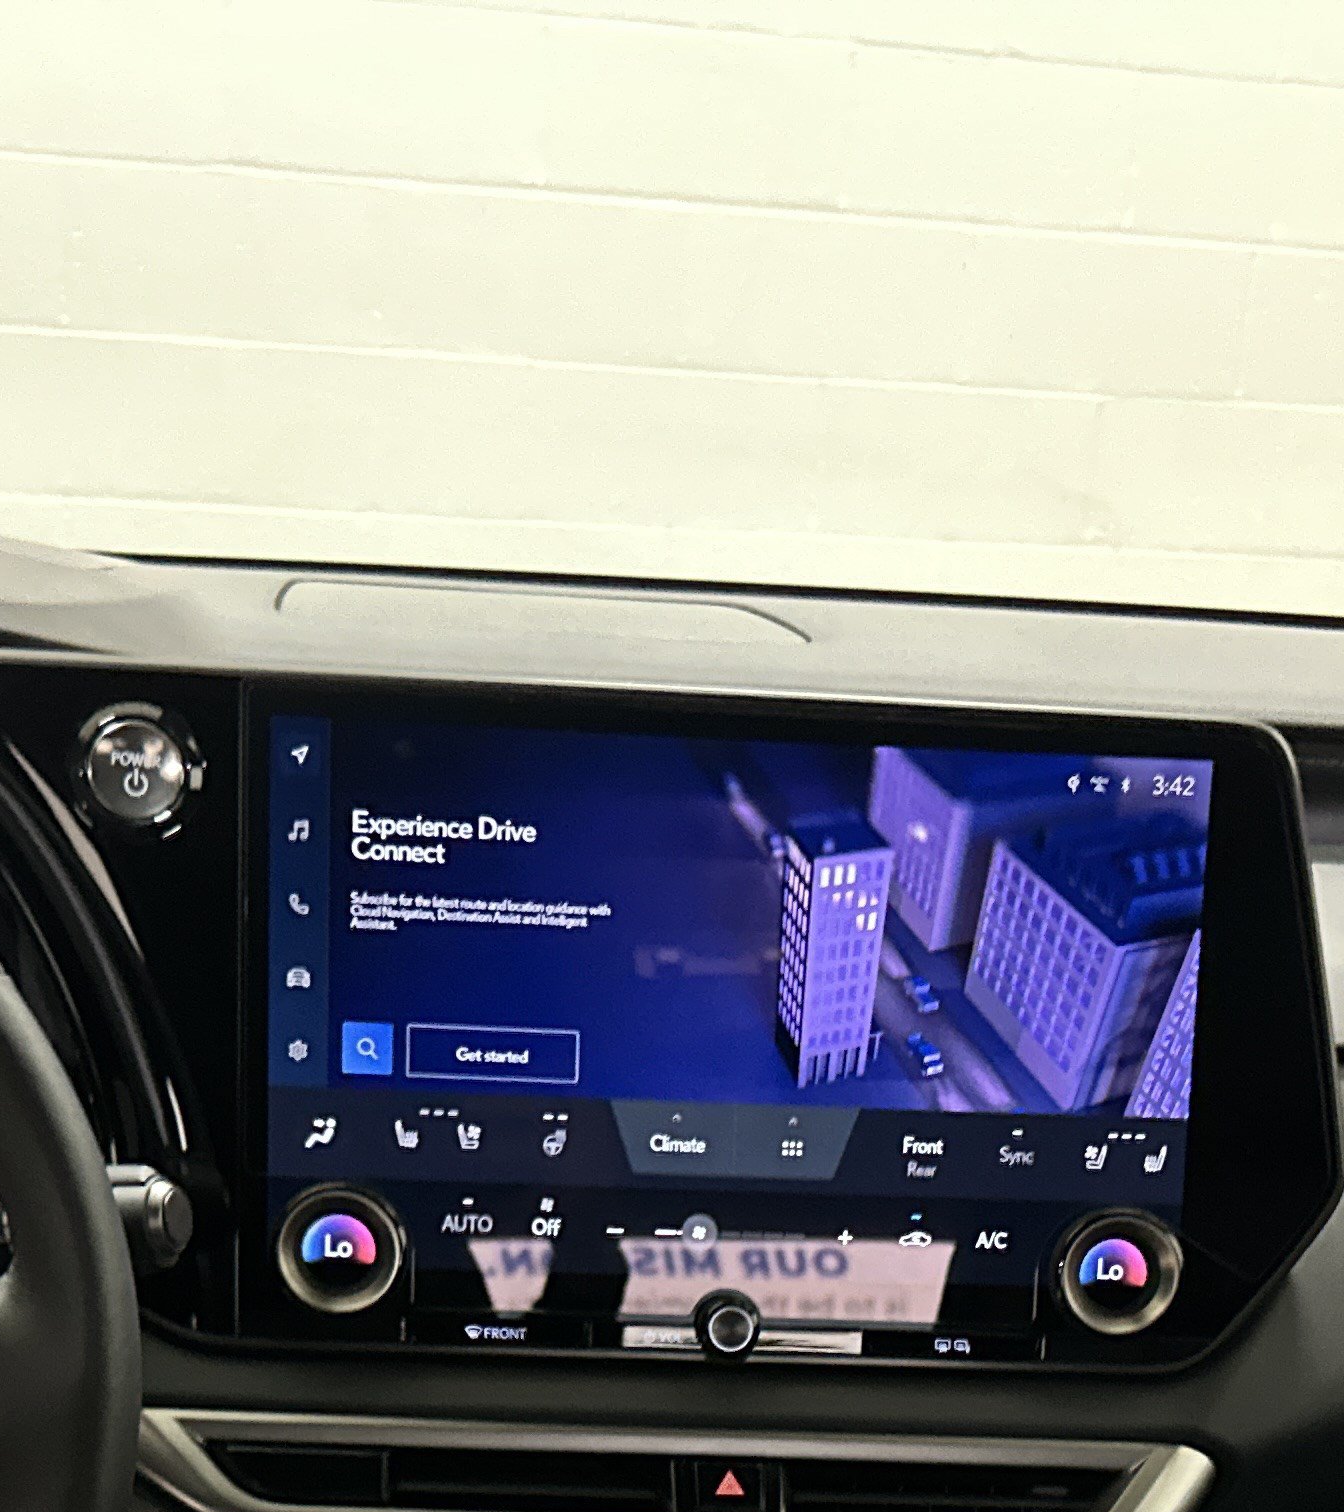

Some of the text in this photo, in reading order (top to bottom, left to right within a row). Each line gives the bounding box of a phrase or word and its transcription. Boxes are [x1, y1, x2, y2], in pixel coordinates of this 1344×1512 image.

[1151, 774, 1197, 797] 3:42
[351, 808, 538, 844] Experience Drive
[350, 836, 447, 865] Connect
[349, 890, 612, 917] Subscribe for the latest route and location guidance with
[349, 904, 382, 918] Cloud
[455, 1045, 530, 1065] Get started
[649, 1133, 707, 1155] Climate
[902, 1135, 944, 1156] Front
[998, 1144, 1035, 1168] Sync
[906, 1160, 938, 1179] Rear
[441, 1212, 494, 1234] AUTO
[531, 1216, 562, 1238] Off
[323, 1232, 354, 1259] Lo
[974, 1229, 1009, 1251] A/C
[1095, 1256, 1125, 1283] Lo
[483, 1325, 528, 1342] FRONT
